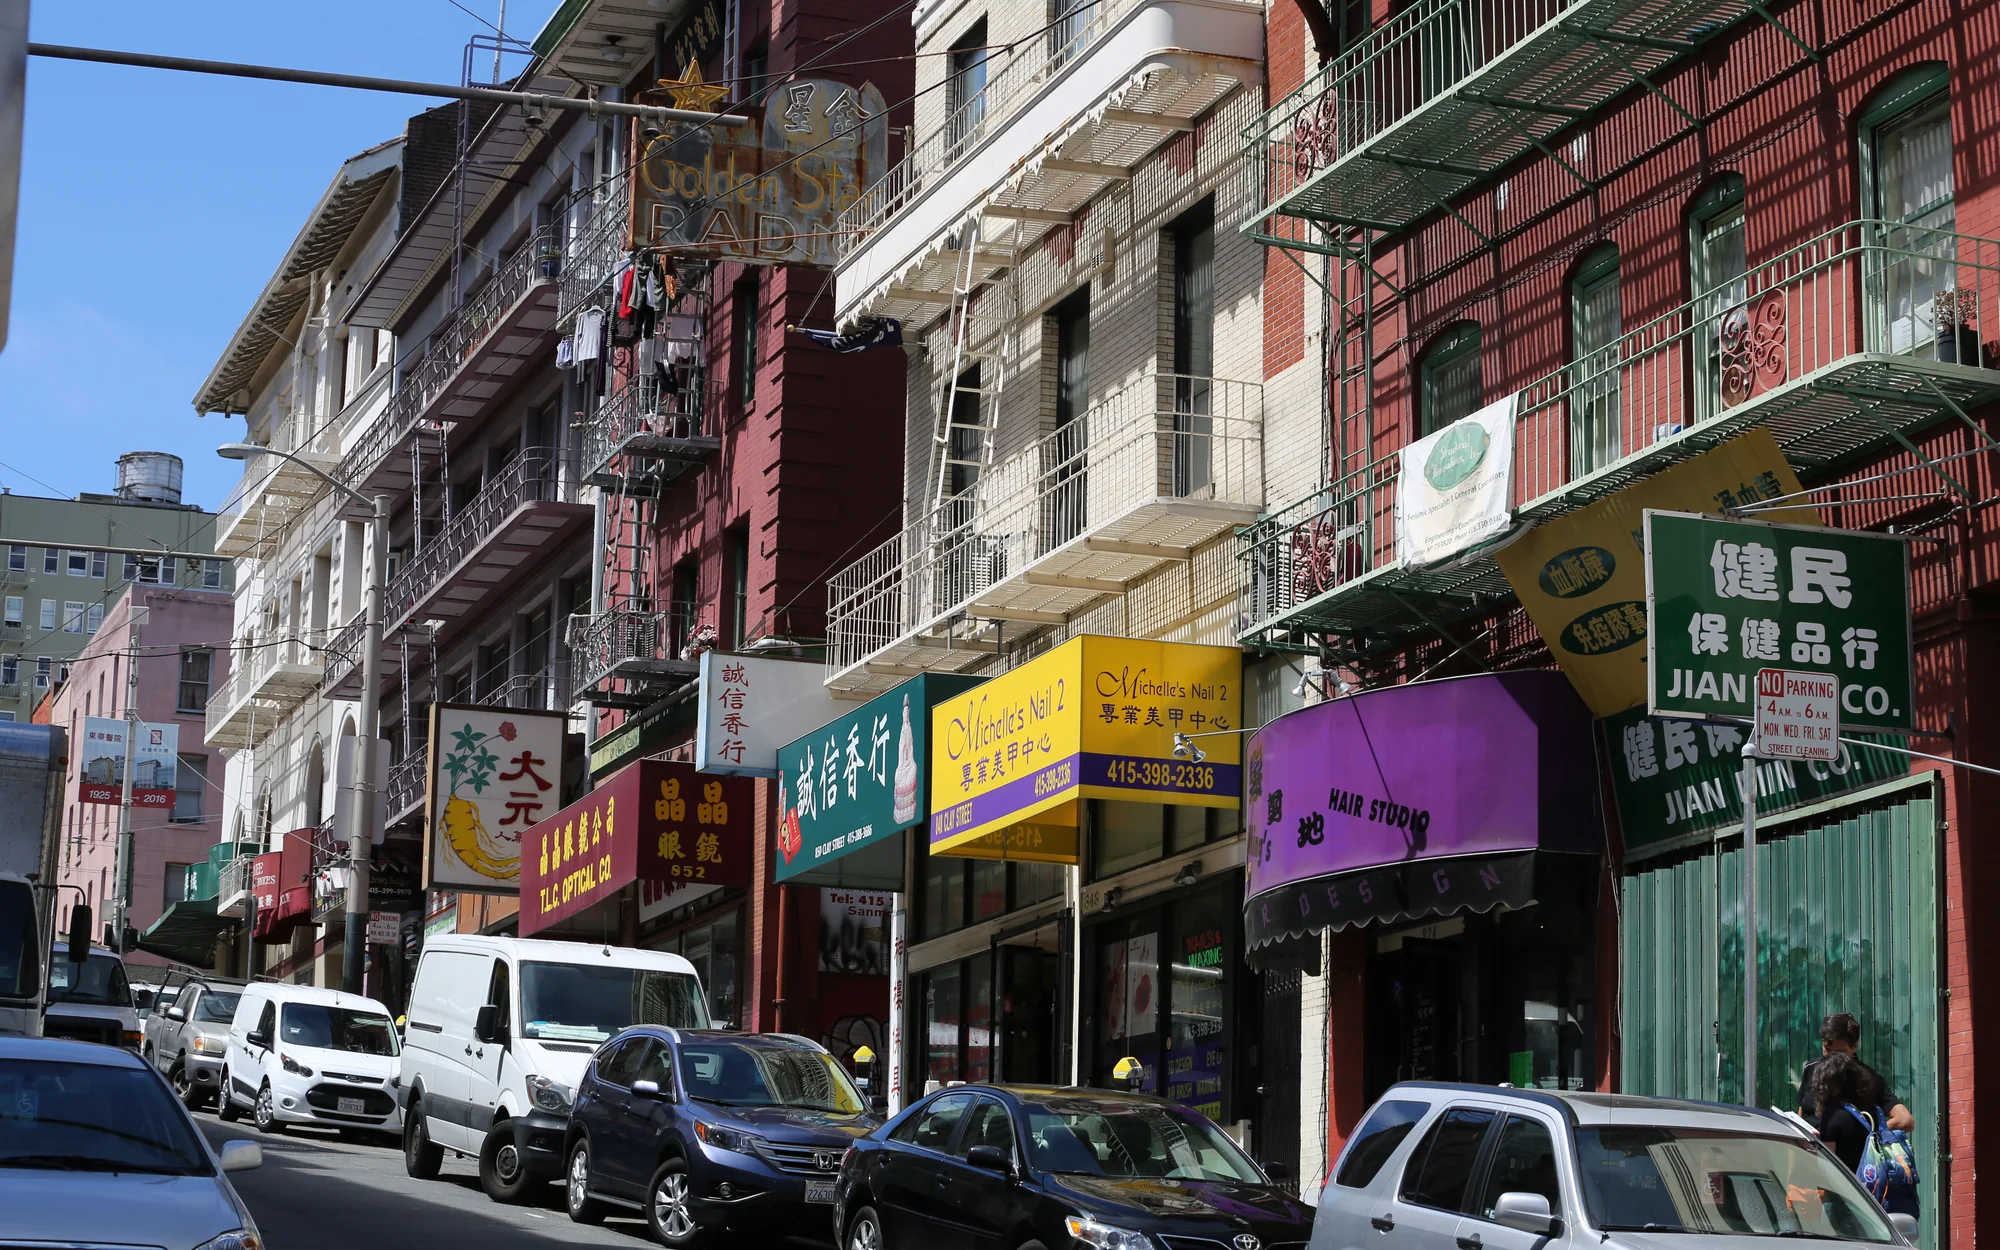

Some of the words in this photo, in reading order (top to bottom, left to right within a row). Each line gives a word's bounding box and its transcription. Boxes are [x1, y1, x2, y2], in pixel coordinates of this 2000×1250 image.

[643, 135, 778, 204] Golden
[1407, 509, 1427, 520] Seismic
[1428, 498, 1451, 515] Specialists
[1454, 485, 1477, 500] General
[1424, 527, 1454, 544] Engineering
[1709, 539, 1852, 609] 健民
[1687, 611, 1879, 670] 保健品行
[1096, 666, 1186, 699] Michelle's
[1191, 683, 1215, 700] Nail
[1219, 685, 1227, 701] 2
[1667, 668, 1746, 703] JIAN
[1841, 684, 1901, 717] CO.
[1762, 672, 1782, 694] NO
[1787, 679, 1834, 699] PARKING
[718, 661, 749, 765] 誠信香行
[947, 693, 1025, 761] Michelle's
[1029, 685, 1052, 725] Nail
[1057, 678, 1065, 712] 2
[1099, 703, 1231, 730] 專業美甲中心
[1767, 700, 1776, 715] 4
[1778, 708, 1792, 717] A.M.
[1805, 703, 1813, 718] 6
[1815, 711, 1829, 720] A.M.
[1764, 722, 1781, 736] MON.
[1784, 724, 1800, 738] WED.
[1803, 726, 1816, 740] FRI.
[1819, 727, 1833, 741] SAT.
[796, 713, 891, 821] 誠信香行
[960, 732, 1052, 792] 專業美甲中心
[1768, 743, 1793, 753] STREET
[1795, 745, 1829, 757] CLEANING
[498, 750, 553, 826] 大元
[1034, 761, 1071, 797] 415-398-2336
[1107, 759, 1214, 789] 415-398-2336
[88, 790, 111, 800] 1925
[143, 794, 167, 803] 2016
[655, 777, 728, 826] 晶晶
[1328, 787, 1364, 819] HAIR
[1368, 798, 1431, 834] STUDIO
[1665, 777, 1727, 825] JIAN
[943, 806, 955, 832] CLAY
[955, 802, 973, 828] STREET
[539, 796, 615, 877] 晶晶眼鏡公司
[656, 830, 723, 864] 眼鏡
[822, 842, 831, 855] CLAY
[831, 836, 845, 852] STREET
[540, 882, 560, 915] T.L.C.
[562, 863, 596, 905] OPTICAL
[598, 854, 612, 883] CO.
[670, 865, 706, 879] 852
[830, 893, 853, 904] Tel:
[858, 894, 885, 906] 415
[370, 912, 379, 921] NO
[380, 912, 398, 922] PARKING
[1186, 931, 1214, 953] NAILS
[1188, 946, 1223, 969] WAXING
[1175, 1055, 1193, 1073] DESIGN
